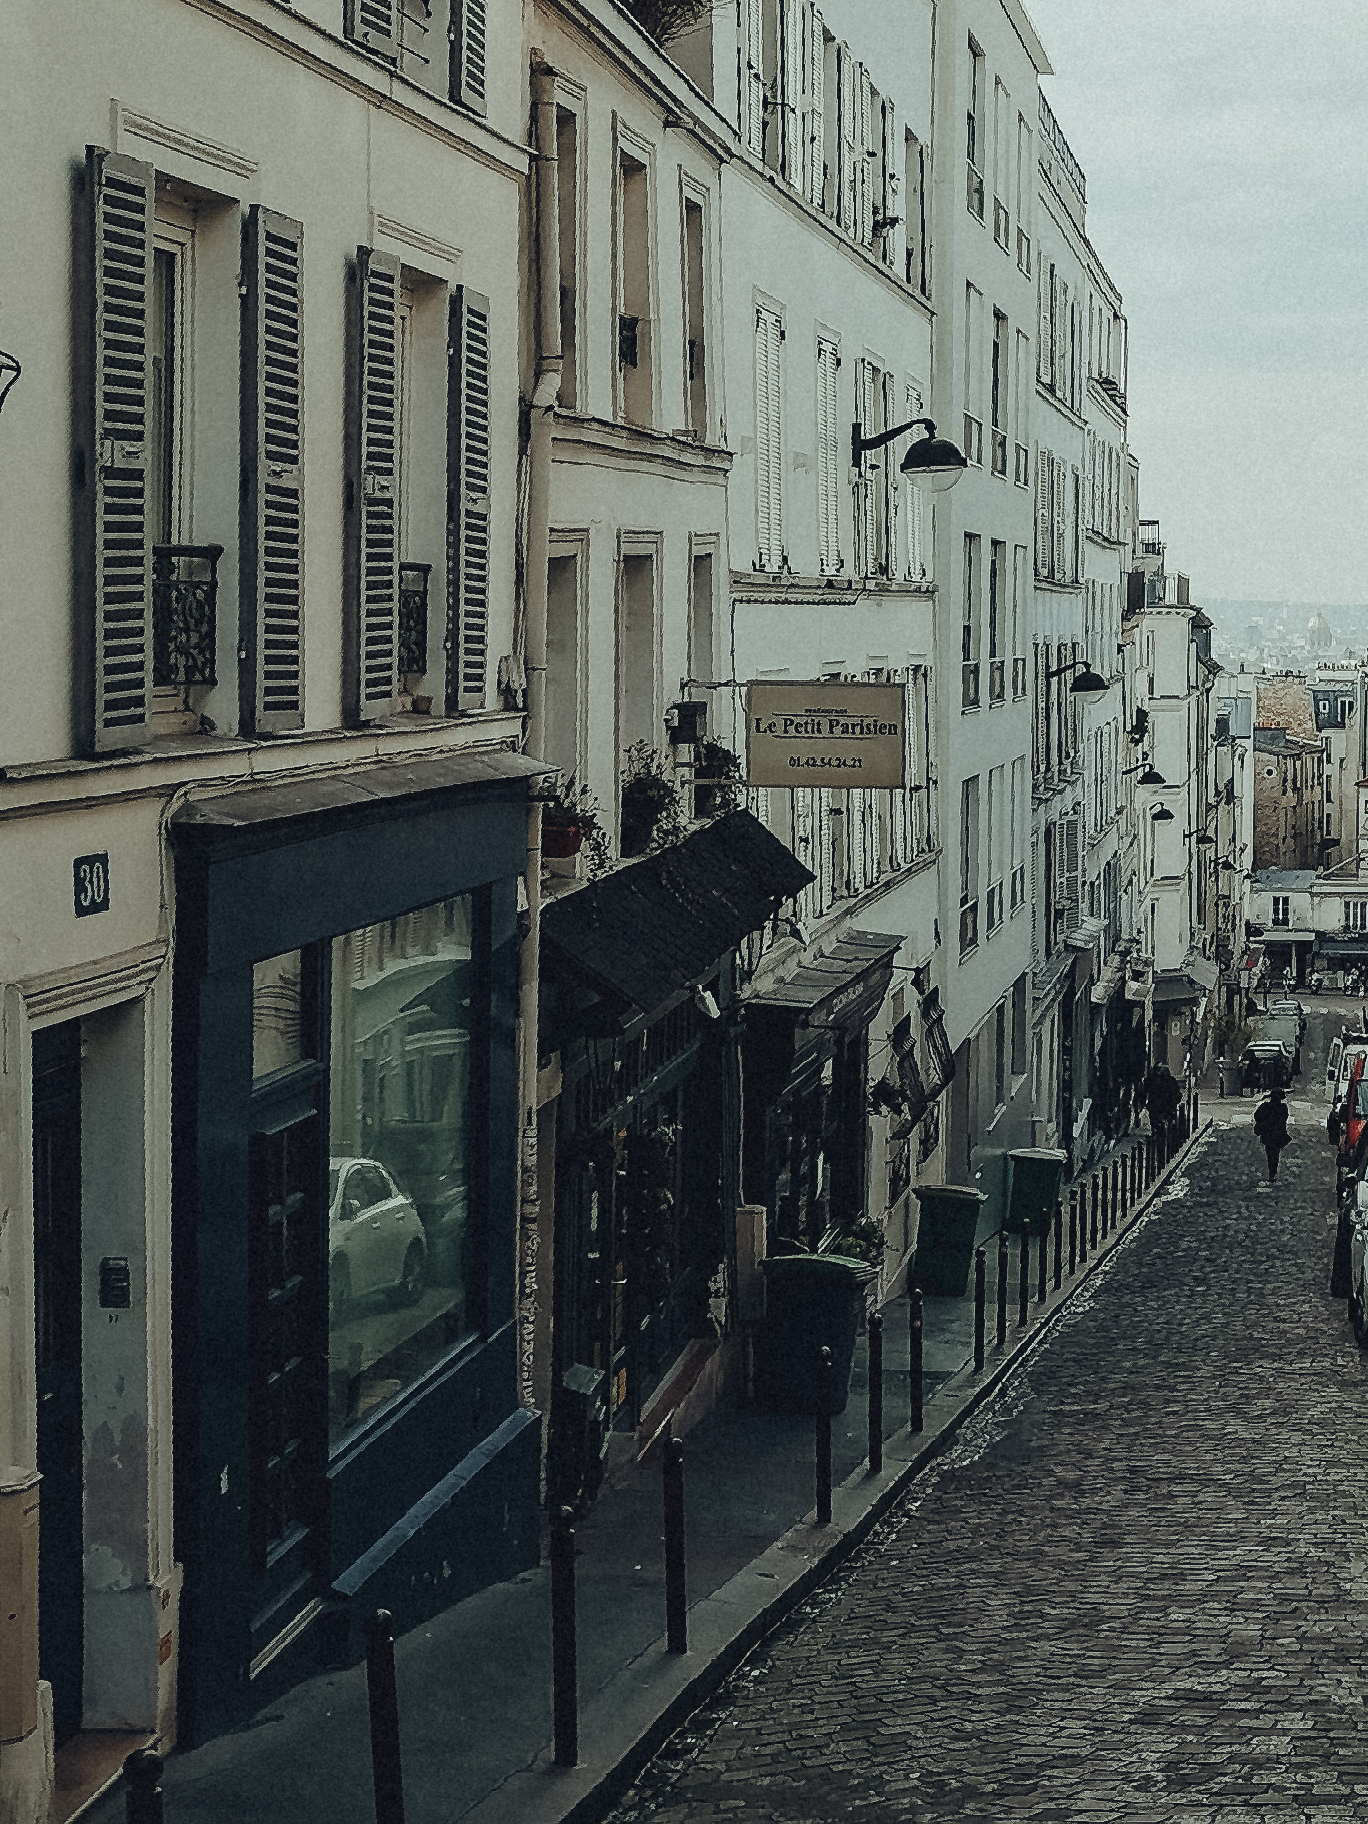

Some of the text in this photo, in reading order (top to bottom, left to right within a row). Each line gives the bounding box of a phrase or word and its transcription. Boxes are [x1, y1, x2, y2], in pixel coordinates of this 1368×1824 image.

[754, 717, 898, 736] Le Petit Parisien
[80, 862, 104, 906] 30
